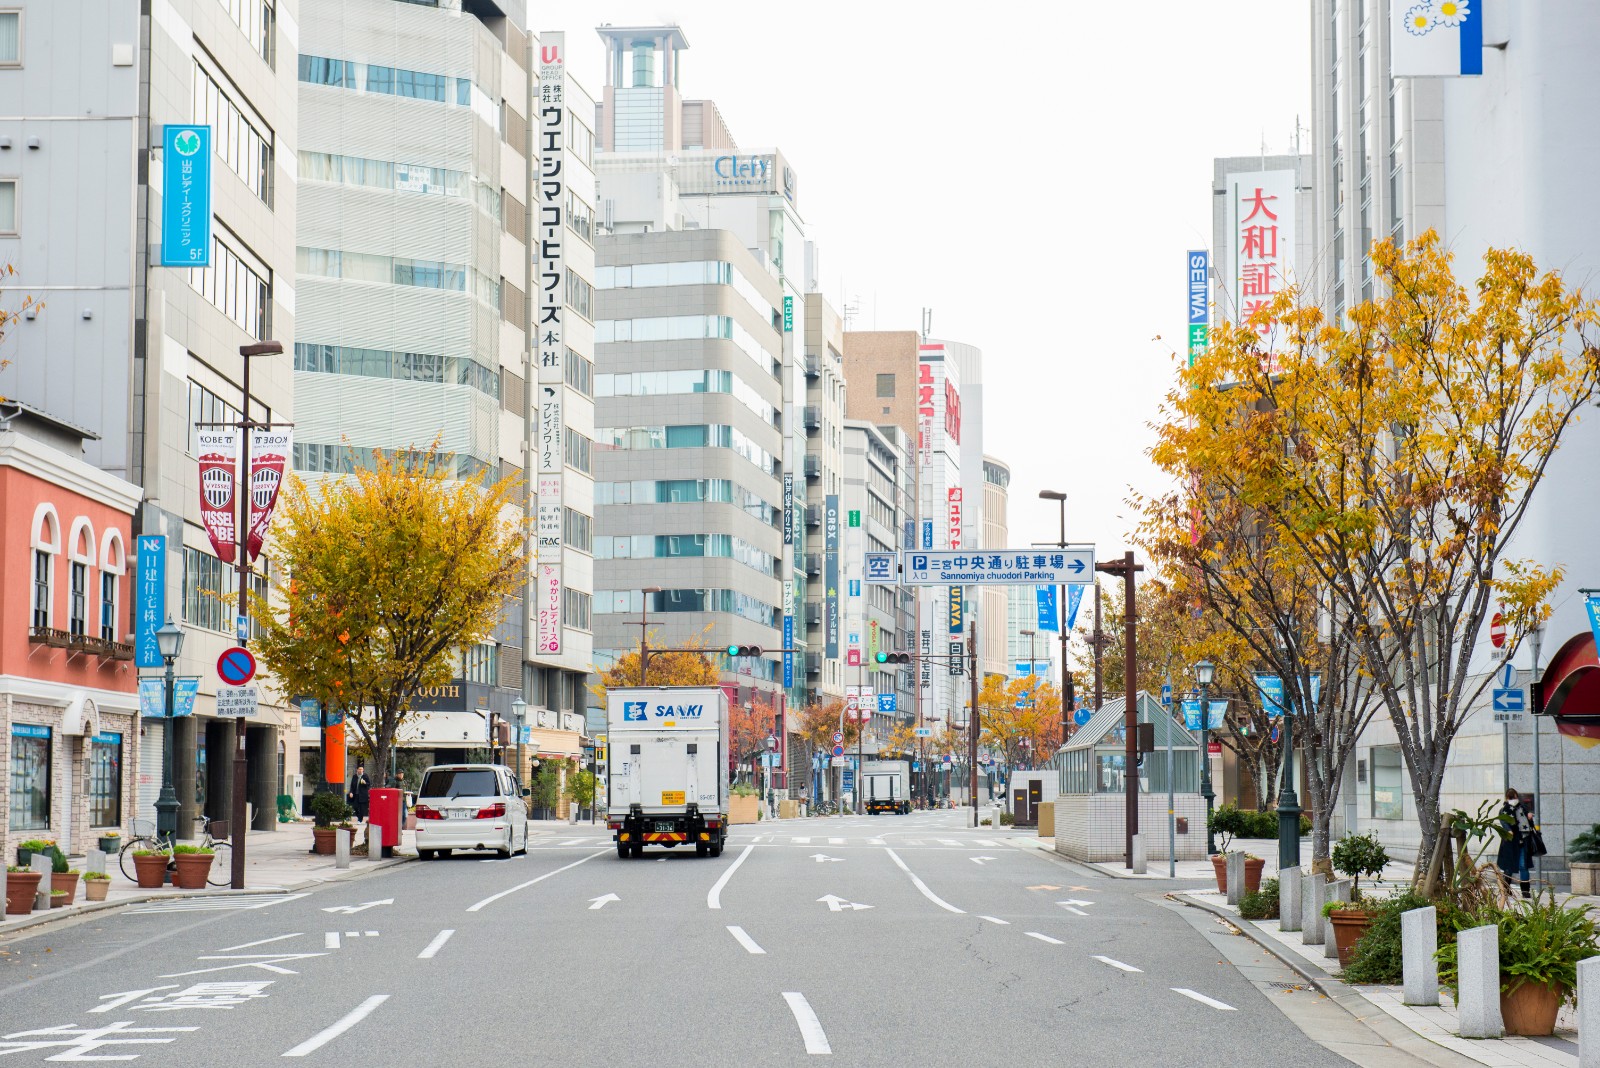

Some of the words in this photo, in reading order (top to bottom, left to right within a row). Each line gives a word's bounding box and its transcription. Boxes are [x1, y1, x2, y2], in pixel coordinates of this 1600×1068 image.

[715, 155, 769, 178] Clefy
[190, 248, 203, 260] 5F
[827, 509, 836, 539] CRSX
[868, 556, 890, 578] 空
[931, 554, 1064, 570] 三宮中央通り駐車場
[940, 571, 984, 581] Sannomiya
[986, 571, 1022, 579] chuodori
[1024, 571, 1055, 581] Parking
[655, 705, 703, 716] SANKI
